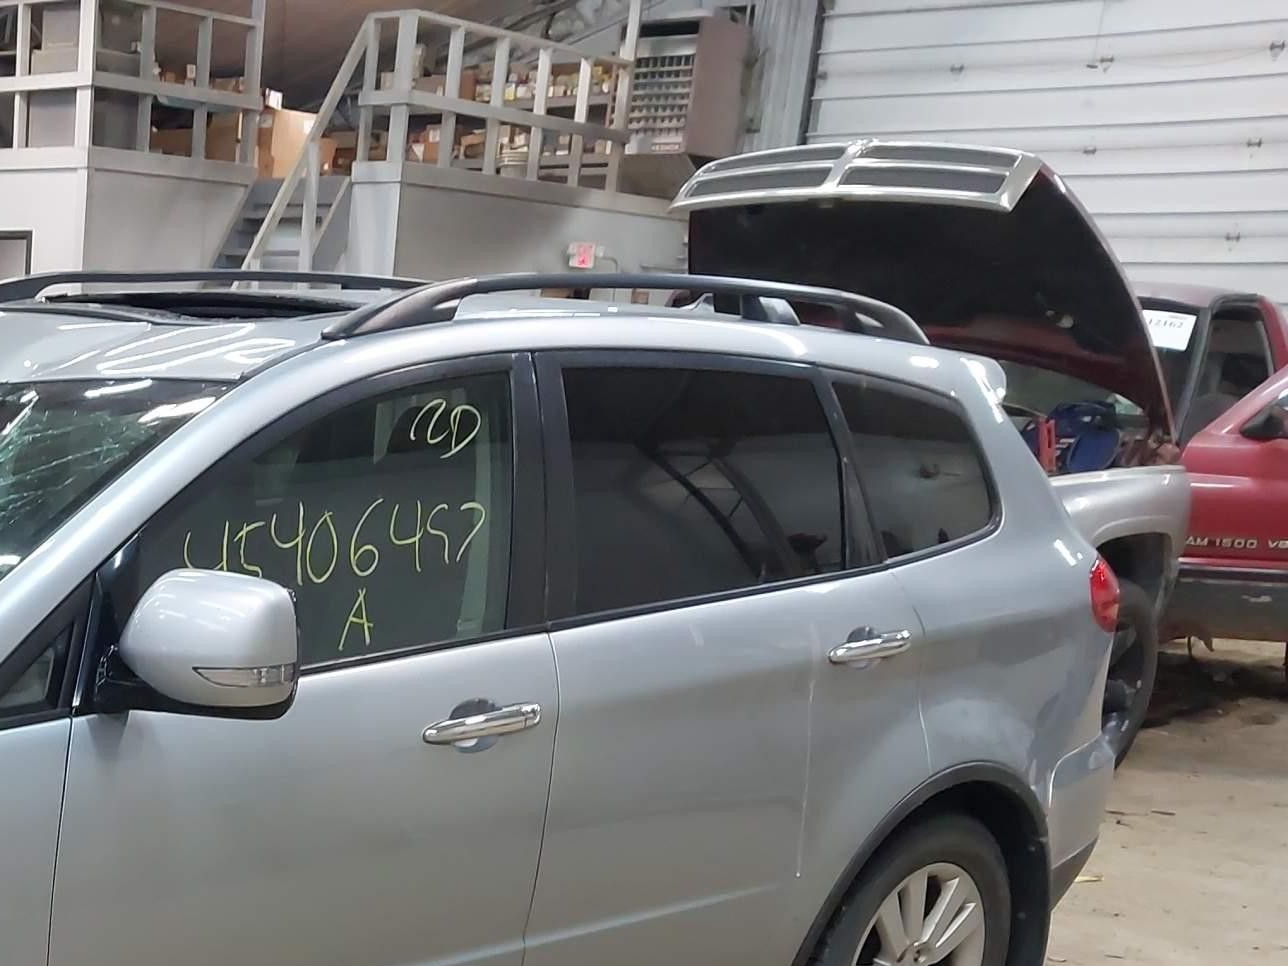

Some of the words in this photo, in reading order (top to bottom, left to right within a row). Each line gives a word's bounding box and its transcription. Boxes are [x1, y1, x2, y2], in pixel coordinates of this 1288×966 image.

[1185, 535, 1209, 547] AM
[1215, 537, 1258, 549] 1500
[338, 587, 374, 651] A
